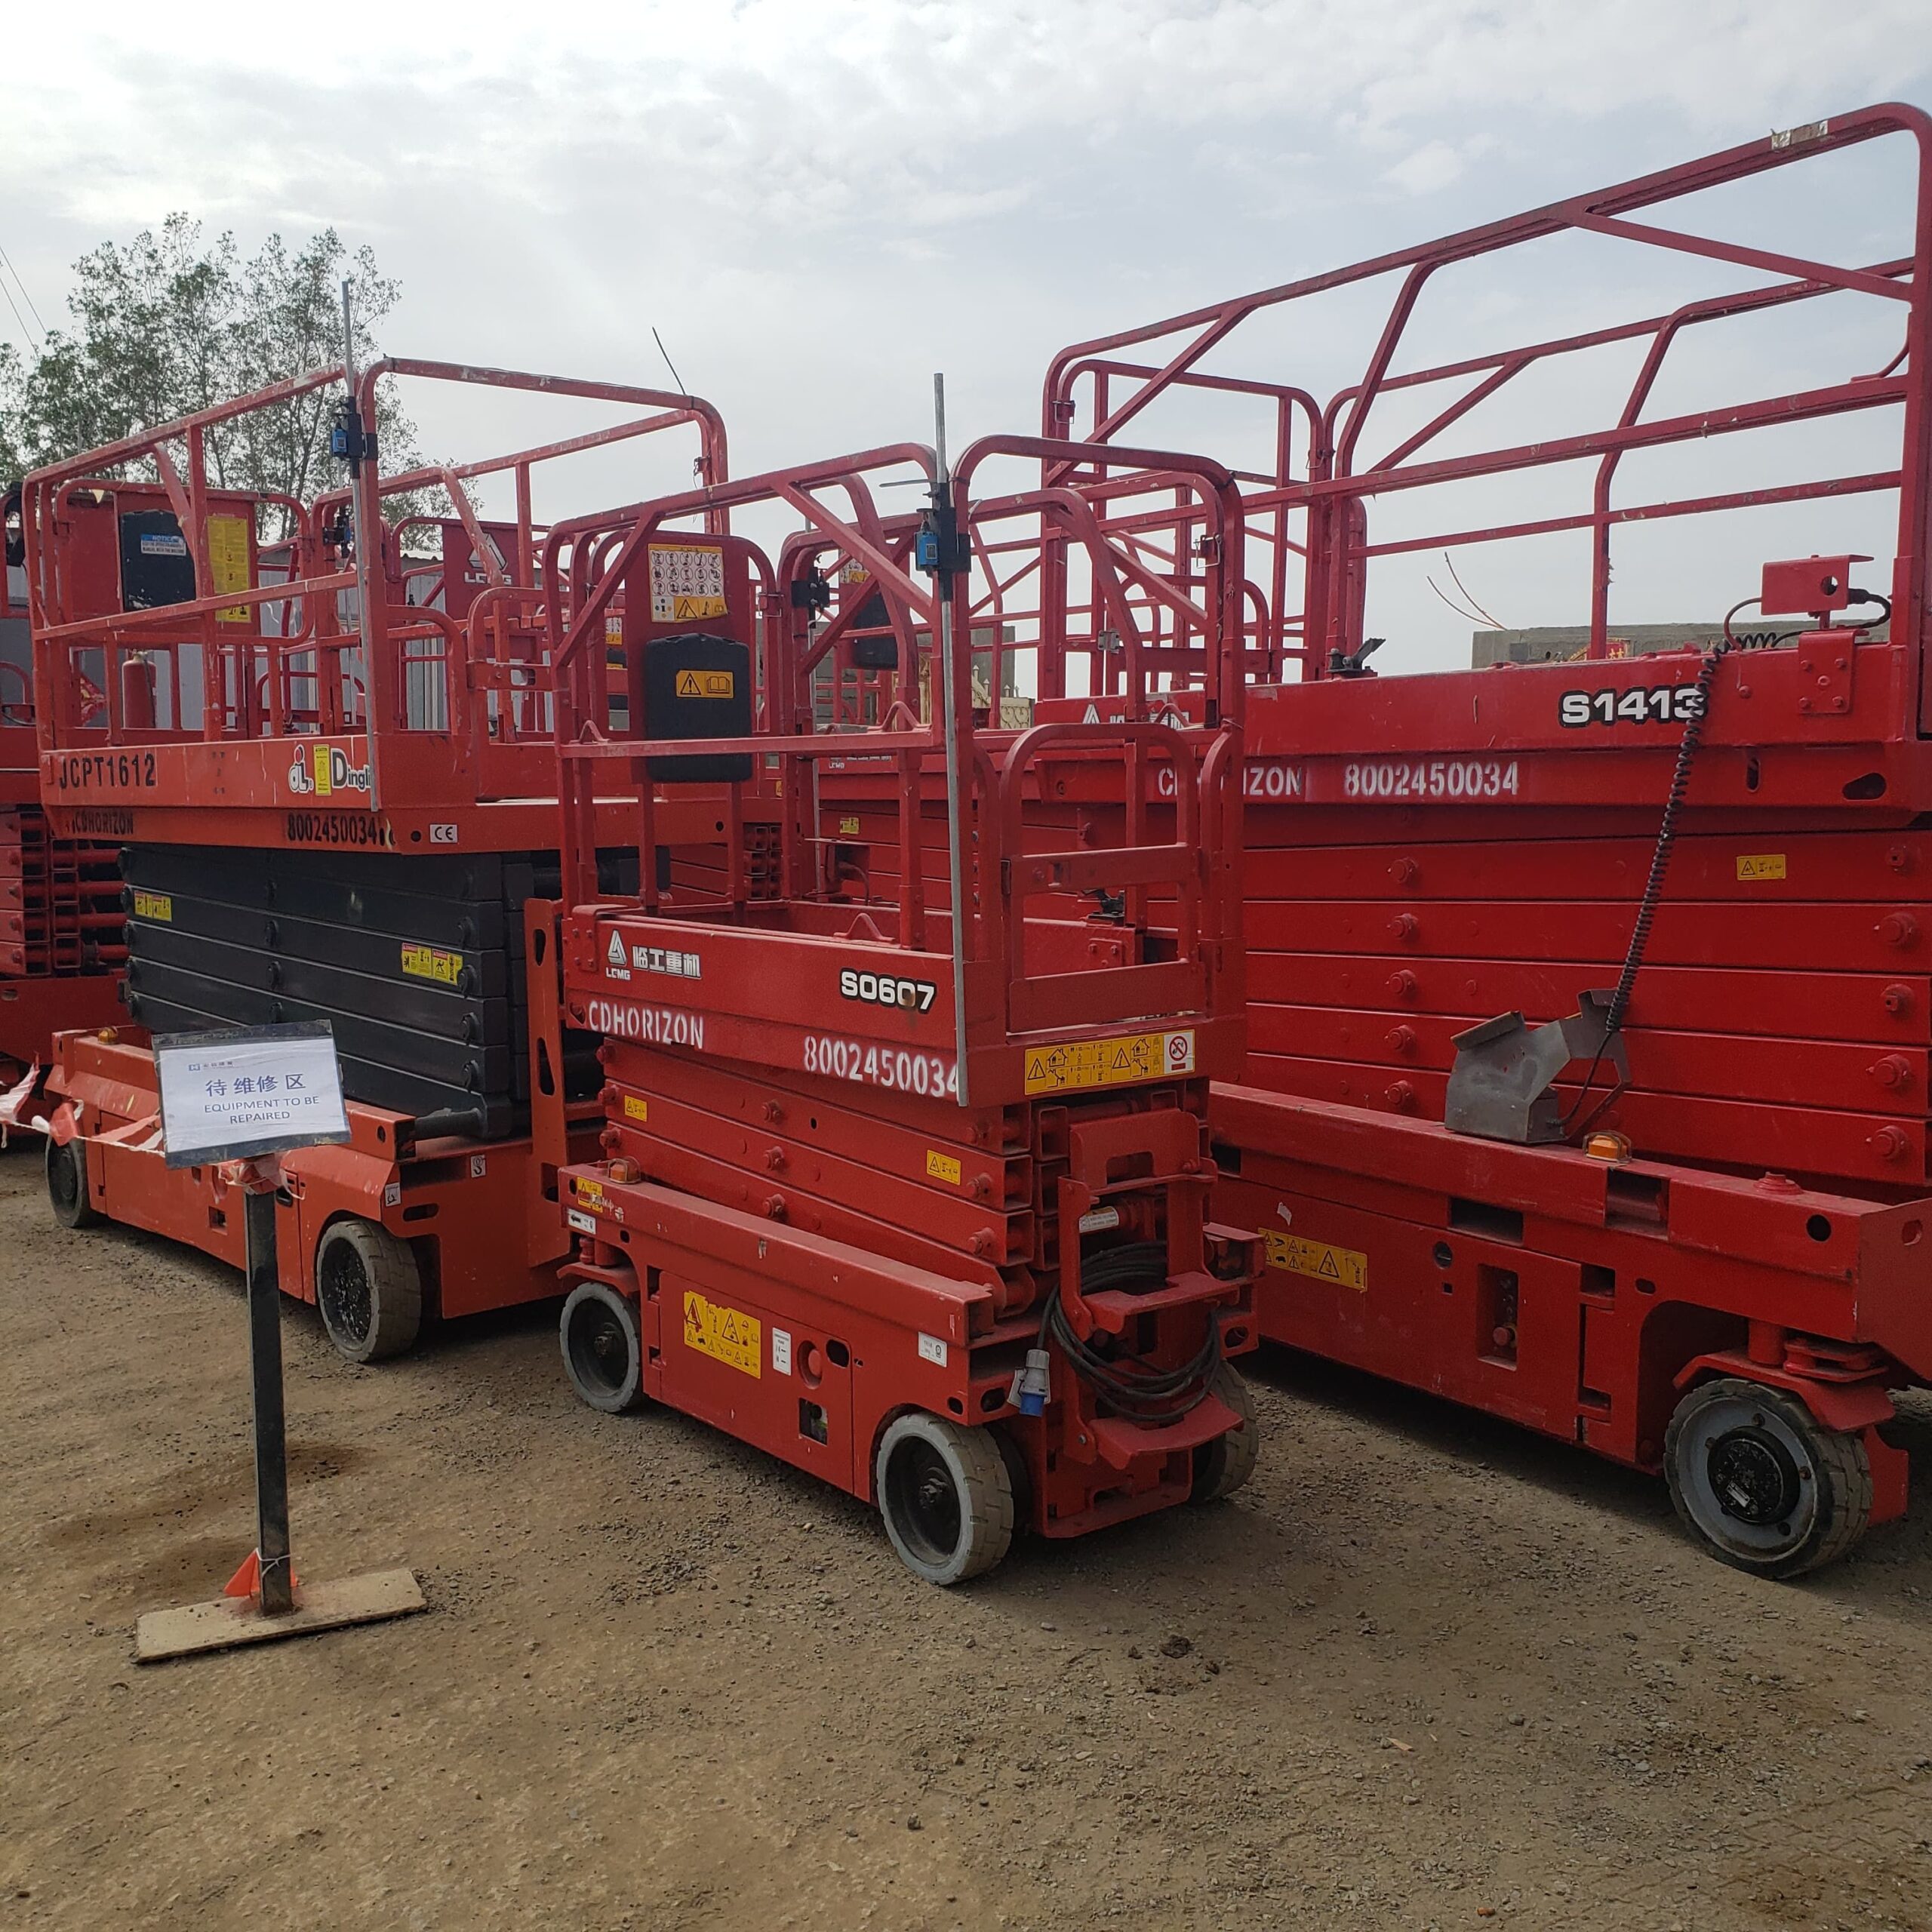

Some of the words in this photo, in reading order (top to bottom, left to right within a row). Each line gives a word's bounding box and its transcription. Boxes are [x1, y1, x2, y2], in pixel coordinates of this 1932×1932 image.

[1561, 688, 1706, 724] S1413
[59, 753, 155, 789] JCPT1612
[1342, 761, 1519, 797] 8002450034
[632, 945, 702, 980] 临工重机
[841, 971, 934, 1010] S0607
[589, 1000, 703, 1050] CDHORIZON
[205, 1072, 306, 1097] 待维修区
[205, 1099, 280, 1113] EQUIPMENT
[283, 1097, 301, 1106] TO
[304, 1096, 320, 1105] BE
[229, 1111, 291, 1124] REPAIRED
